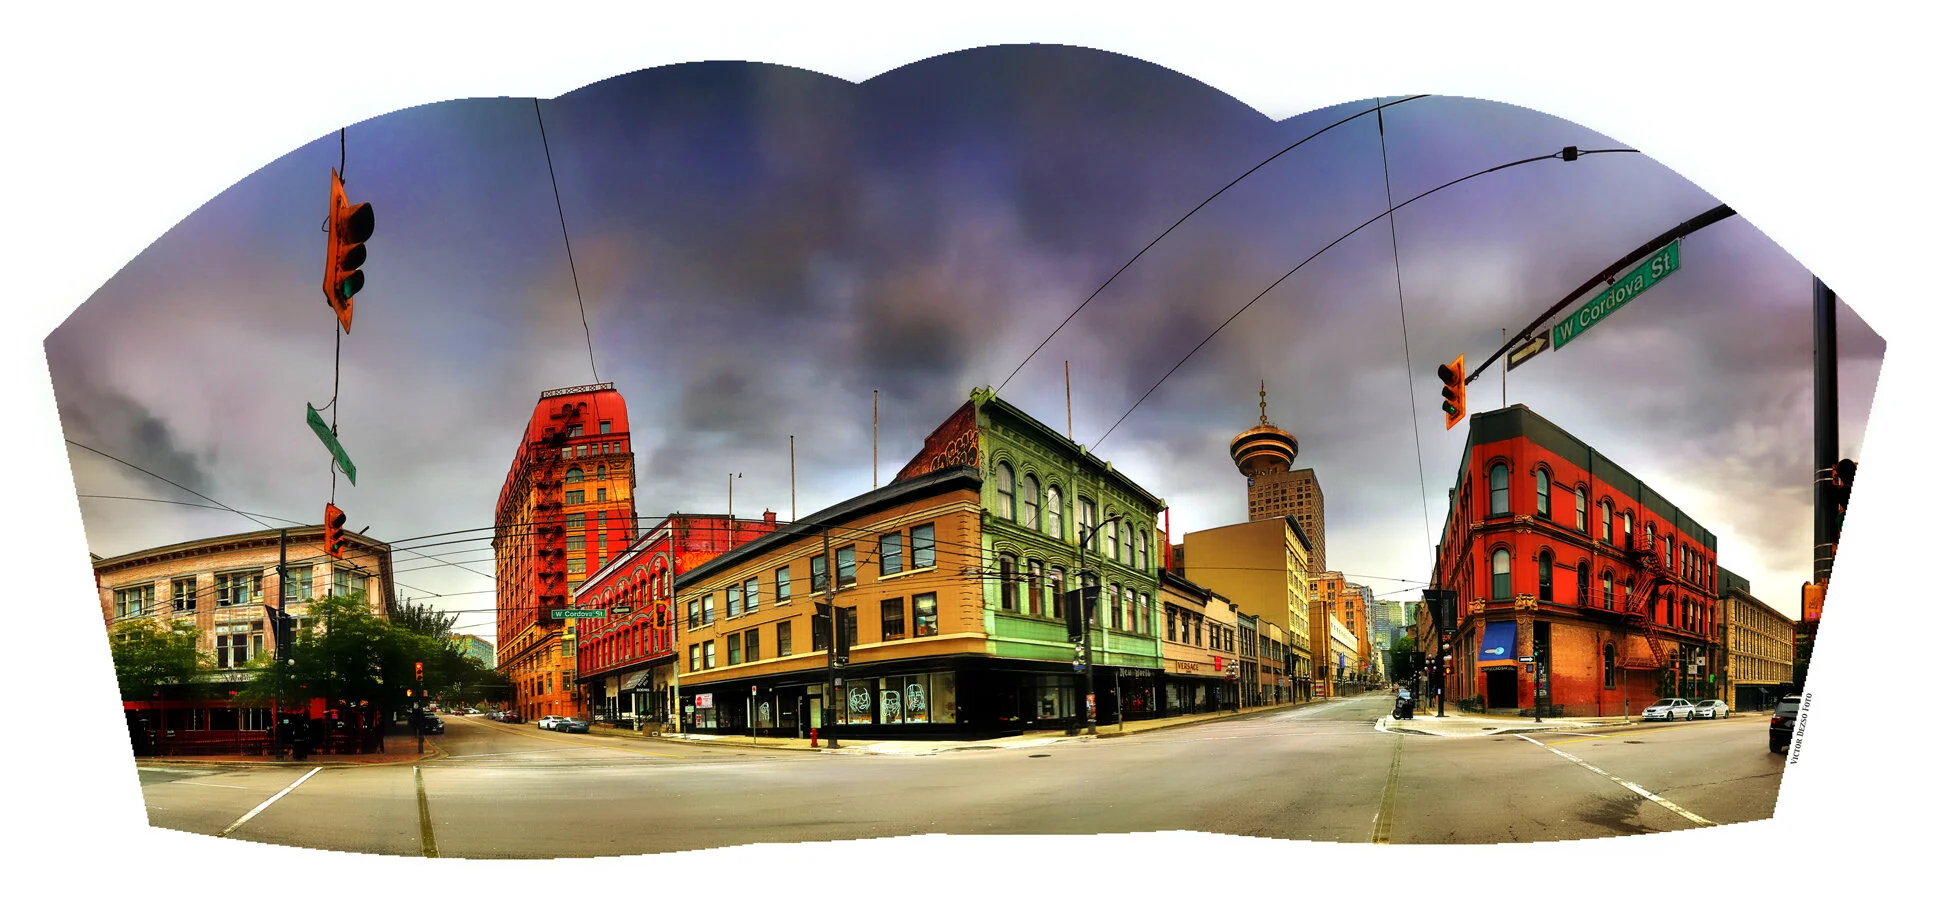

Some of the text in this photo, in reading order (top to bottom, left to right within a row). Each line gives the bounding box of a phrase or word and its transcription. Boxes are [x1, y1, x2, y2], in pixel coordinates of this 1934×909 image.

[1559, 252, 1671, 341] W Cordova St
[1178, 662, 1199, 671] VERSACE
